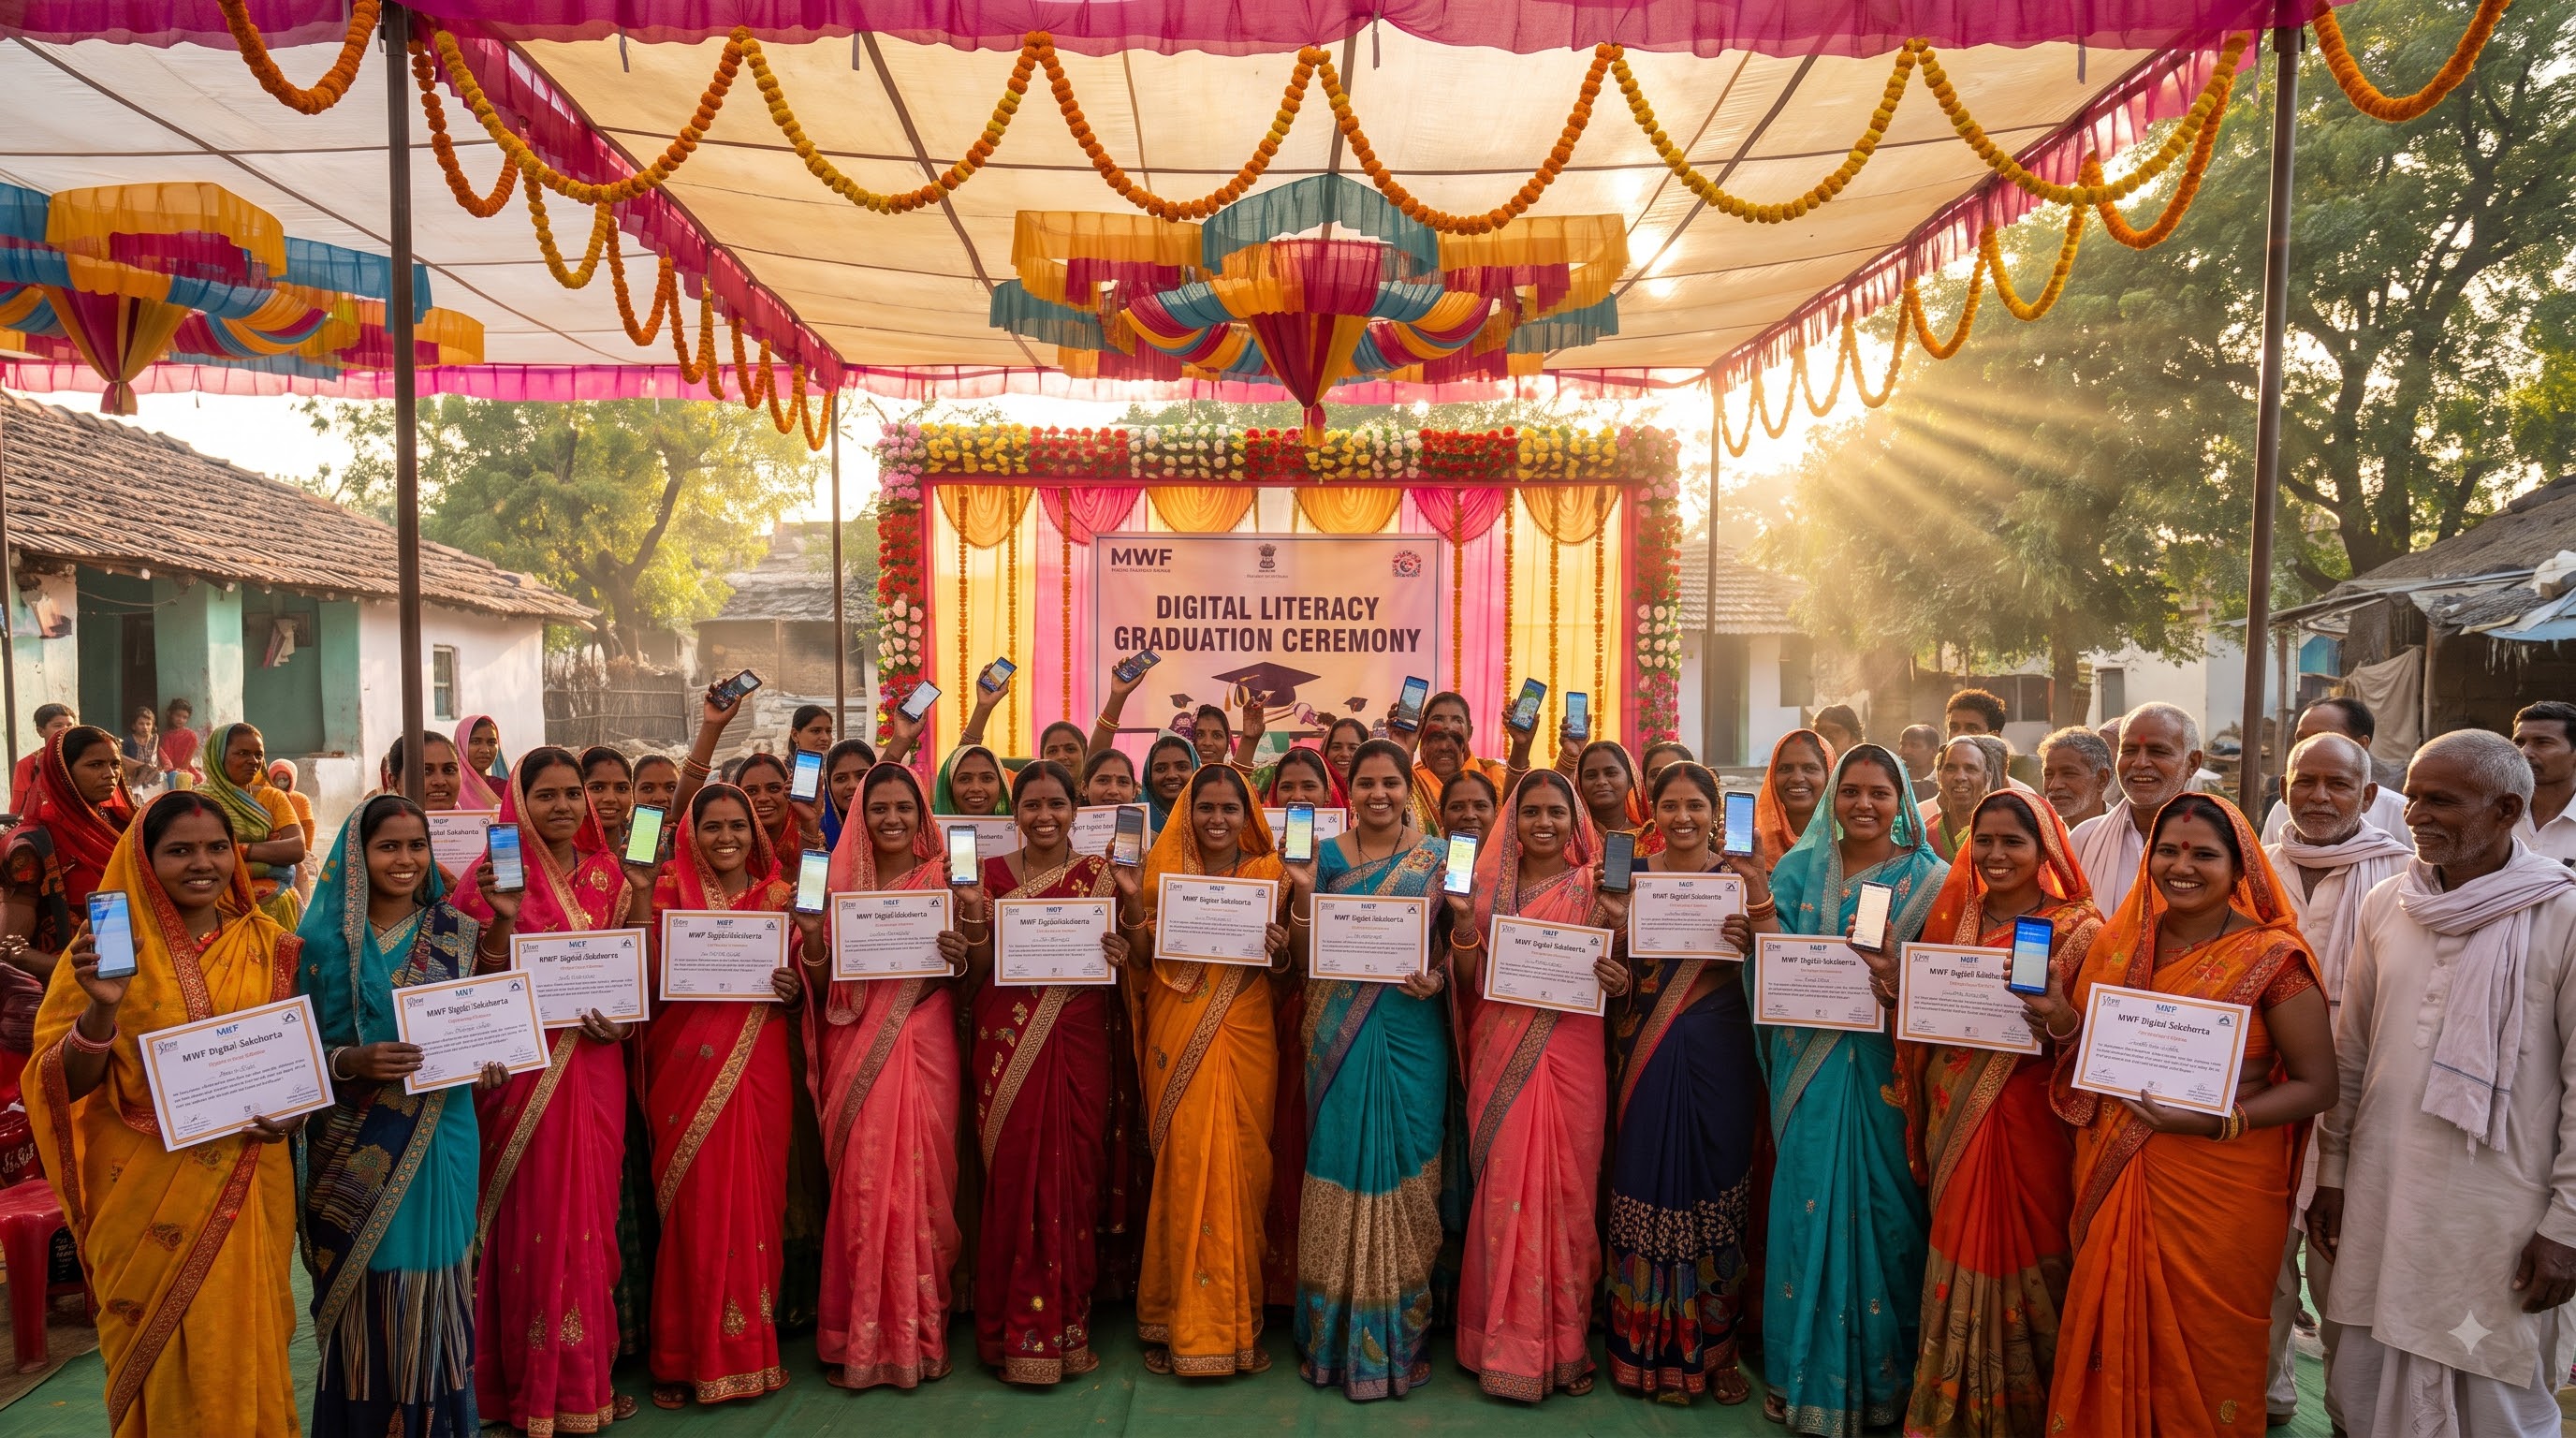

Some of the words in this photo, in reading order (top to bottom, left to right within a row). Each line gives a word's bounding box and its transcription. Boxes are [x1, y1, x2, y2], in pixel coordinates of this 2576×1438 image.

[1111, 548, 1173, 565] MWF
[1156, 594, 1251, 621] DIGITAL
[1260, 595, 1380, 621] LITERACY
[1114, 626, 1272, 653] GRADUATION
[1282, 628, 1422, 653] CEREMONY
[1929, 967, 1949, 976] MWF
[2117, 1014, 2140, 1023] MWF
[182, 1049, 206, 1063] MWF
